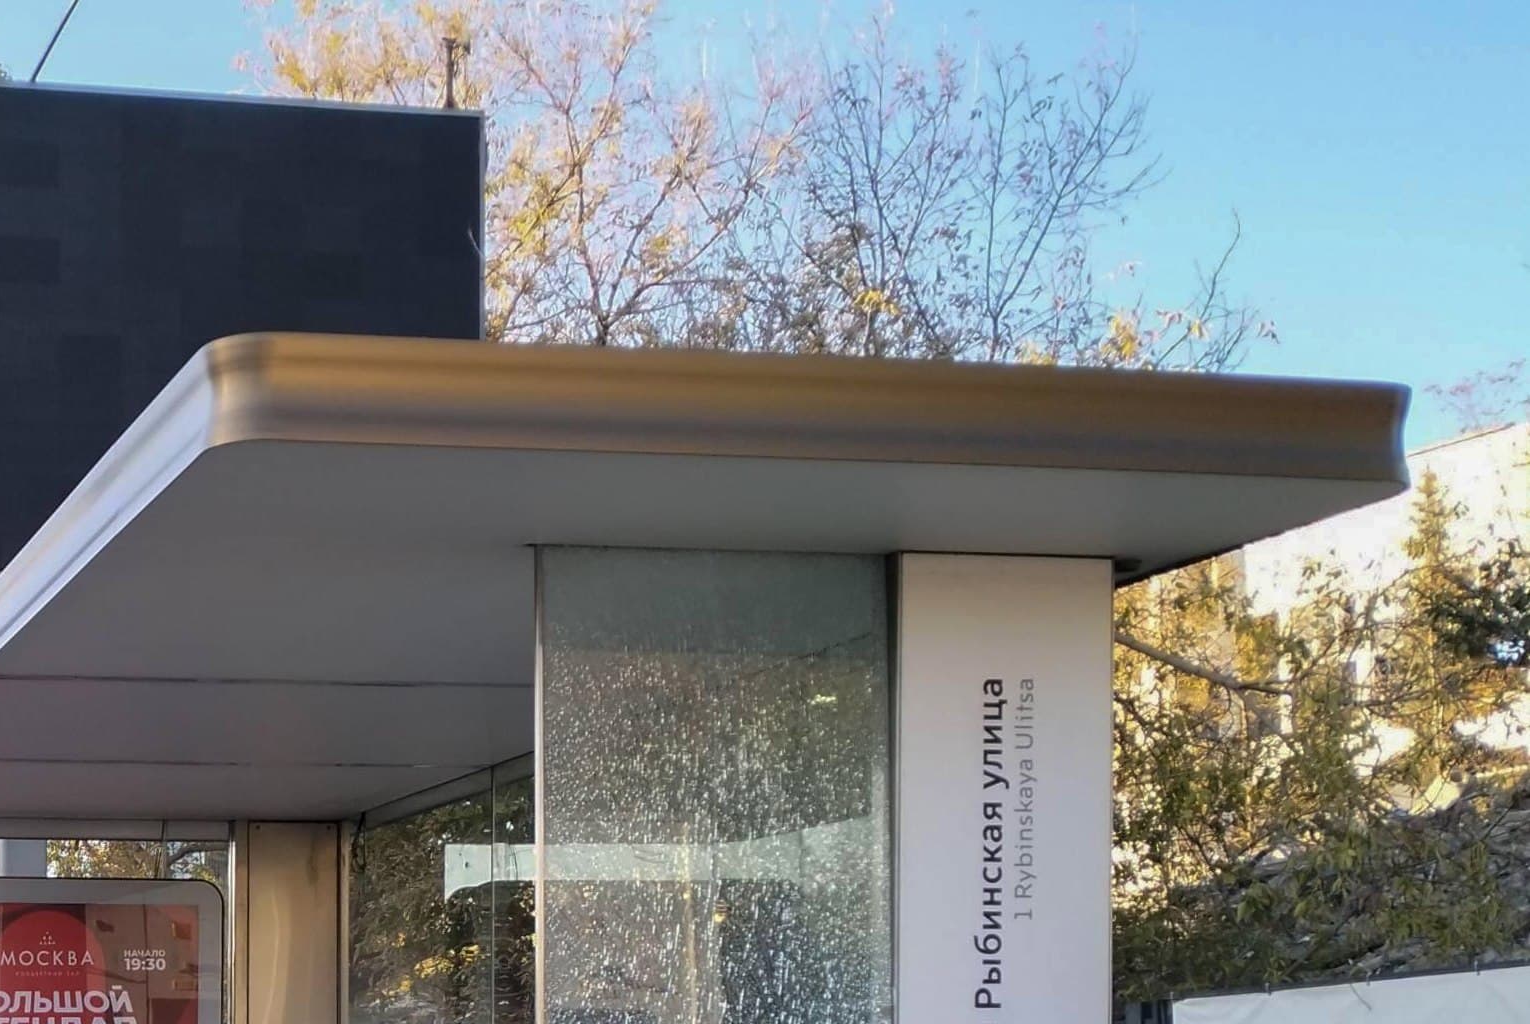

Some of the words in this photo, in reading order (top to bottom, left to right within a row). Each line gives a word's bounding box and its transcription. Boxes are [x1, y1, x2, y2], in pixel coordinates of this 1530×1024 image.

[982, 677, 1010, 790] улица
[1014, 677, 1035, 750] Ulitsa
[1014, 758, 1038, 900] Rybinskaya
[974, 801, 1003, 1009] Рыбинская
[1014, 908, 1033, 921] 1
[0, 950, 95, 967] МОСКВА
[123, 949, 166, 958] НАЧАЛО
[124, 958, 166, 971] 19:30
